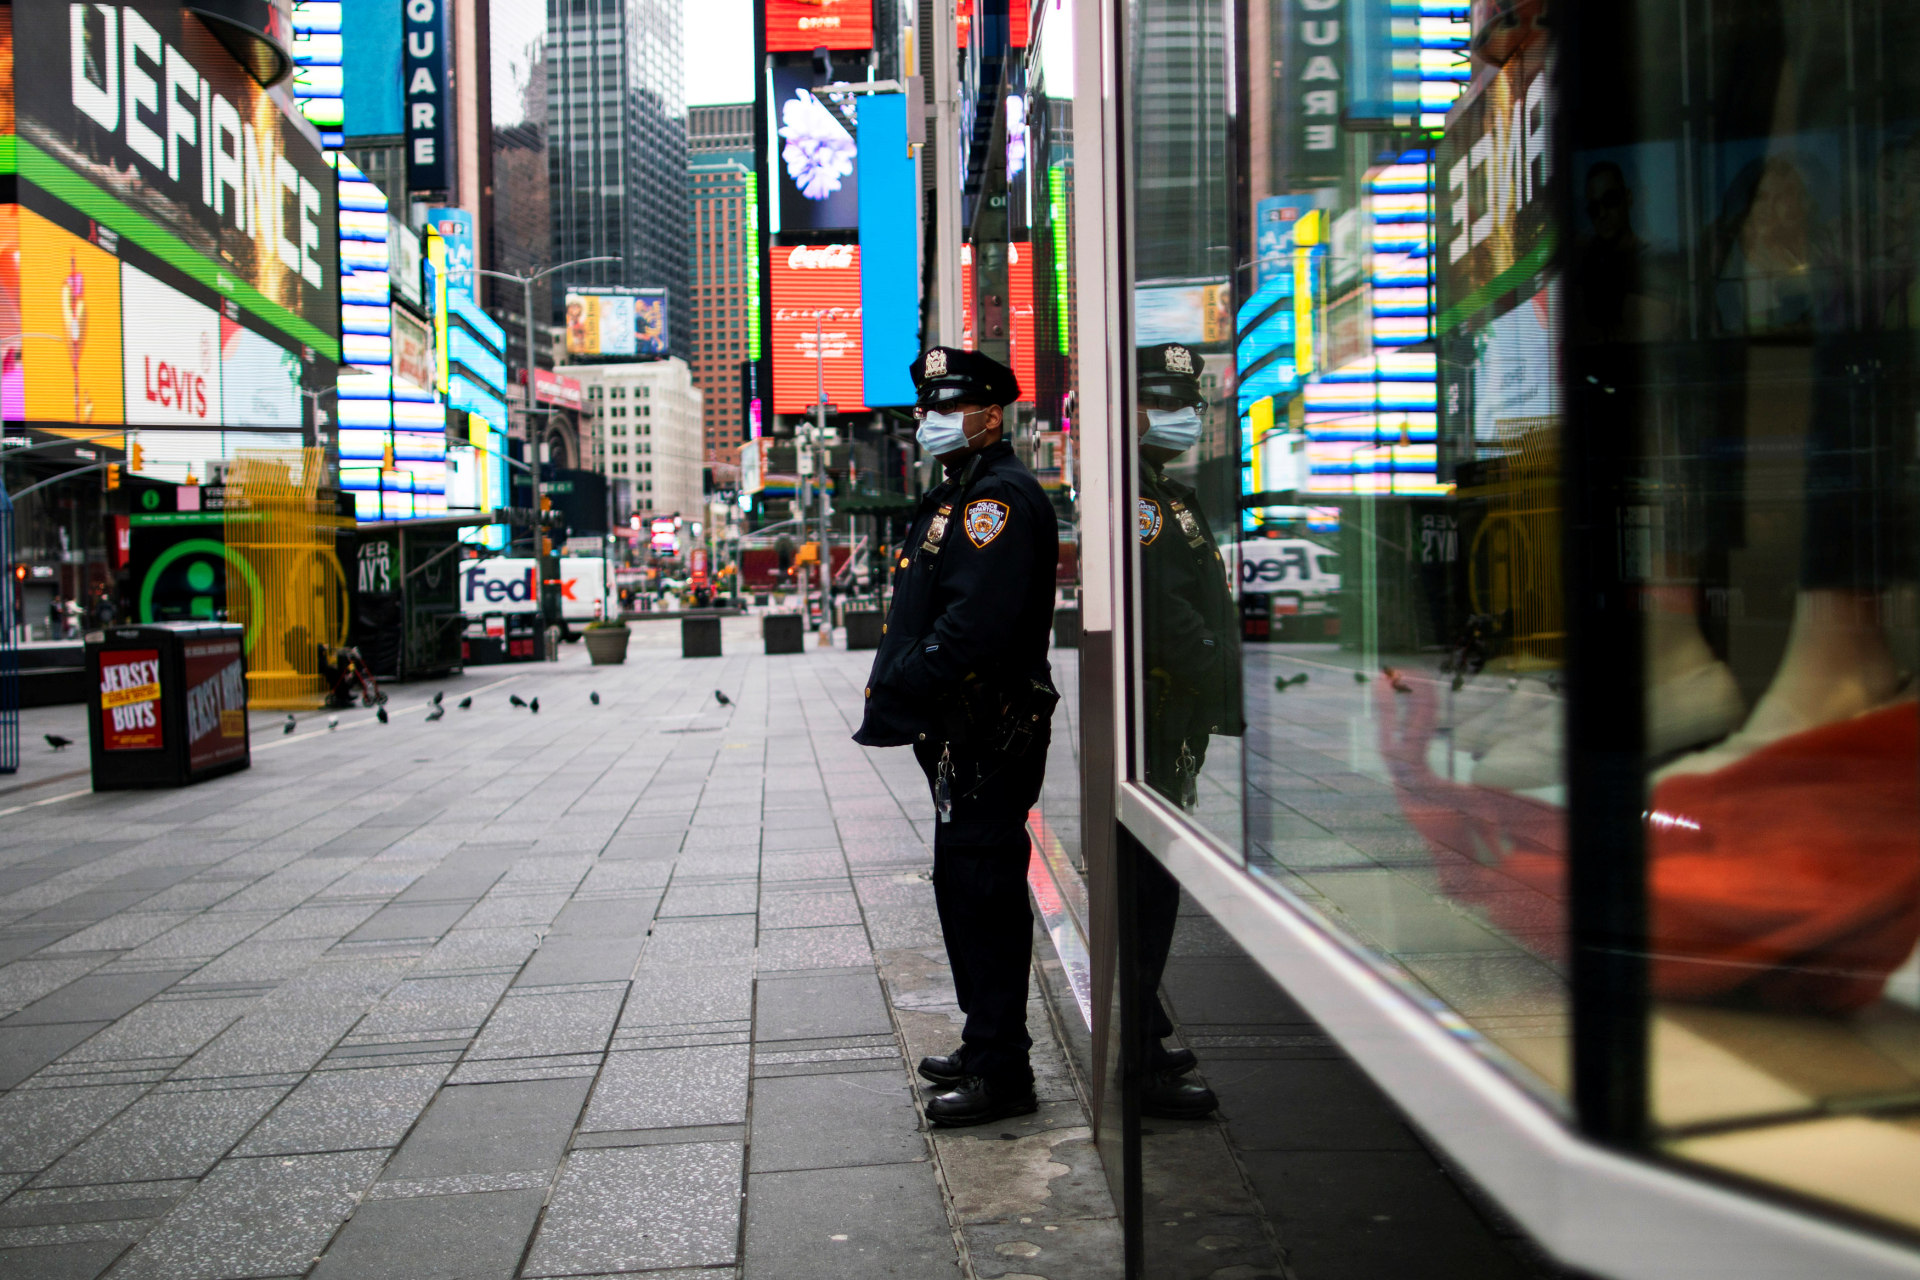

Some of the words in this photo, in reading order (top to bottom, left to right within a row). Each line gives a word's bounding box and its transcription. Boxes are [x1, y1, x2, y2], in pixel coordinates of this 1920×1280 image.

[406, 0, 437, 165] QUARE
[69, 2, 322, 290] DEFIANCE
[968, 506, 1004, 518] DEPARTMENT
[976, 502, 998, 510] POLICE
[101, 658, 160, 693] JERSEY
